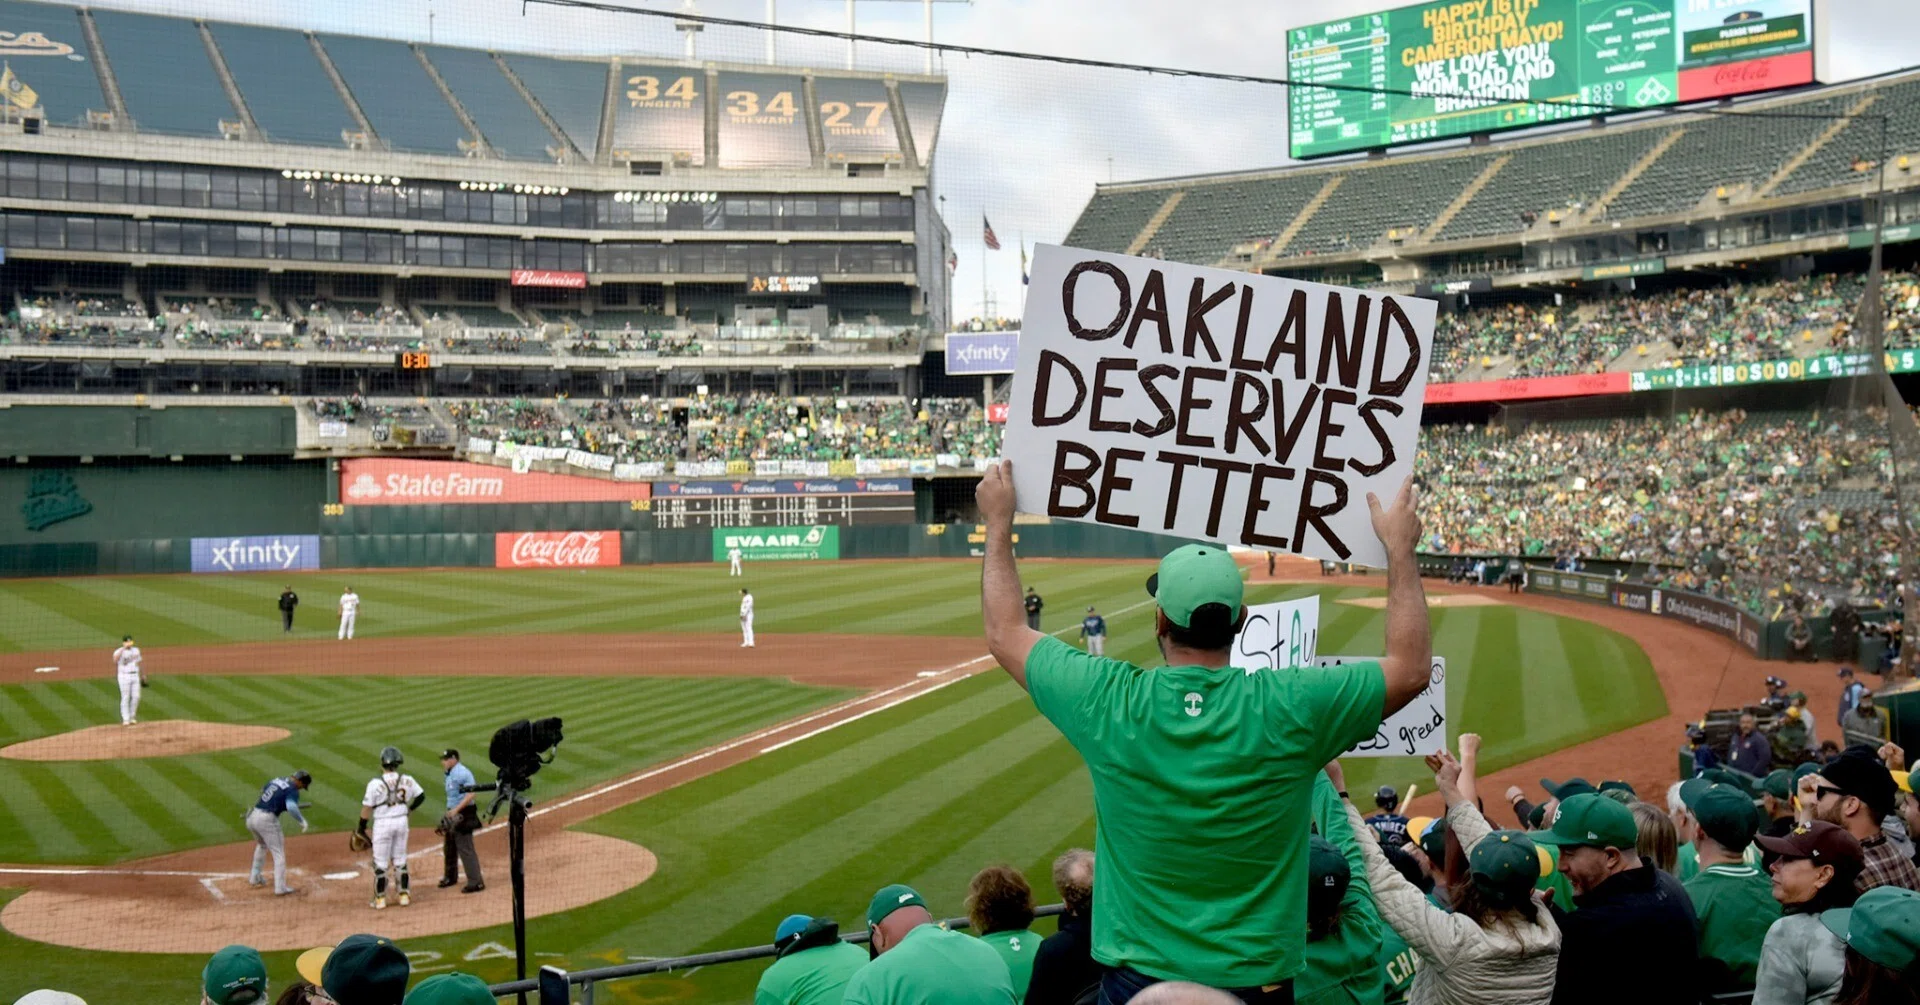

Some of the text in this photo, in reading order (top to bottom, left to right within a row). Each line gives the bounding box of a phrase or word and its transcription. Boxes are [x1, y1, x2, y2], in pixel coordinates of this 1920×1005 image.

[1423, 1, 1486, 28] HAPPY
[1433, 10, 1529, 44] BIRTHDAY
[1325, 22, 1352, 35] RAYS
[1402, 20, 1564, 67] CAMERON MAYO!
[1414, 41, 1550, 82] WE LOVE YOU!
[1467, 66, 1508, 91] DAD
[1512, 58, 1556, 84] AND
[627, 76, 699, 101] 34
[1435, 80, 1530, 113] BRANDON
[631, 100, 692, 108] FINGERS
[726, 91, 799, 117] 34
[821, 102, 889, 128] 27
[515, 270, 583, 286] Budweiser
[1062, 260, 1421, 397] OAKLAND
[956, 343, 1011, 364] xfinity
[1809, 360, 1820, 374] 4
[1902, 352, 1914, 369] 5
[1032, 349, 1404, 477] DESERVES
[680, 482, 899, 494] Fanatics Fanatics Fanatics Fanatics
[1047, 440, 1352, 561] BETTER
[630, 500, 650, 511] 362
[212, 539, 300, 571] xfinity
[511, 531, 604, 565] Coca-Cola
[1399, 704, 1445, 755] greed
